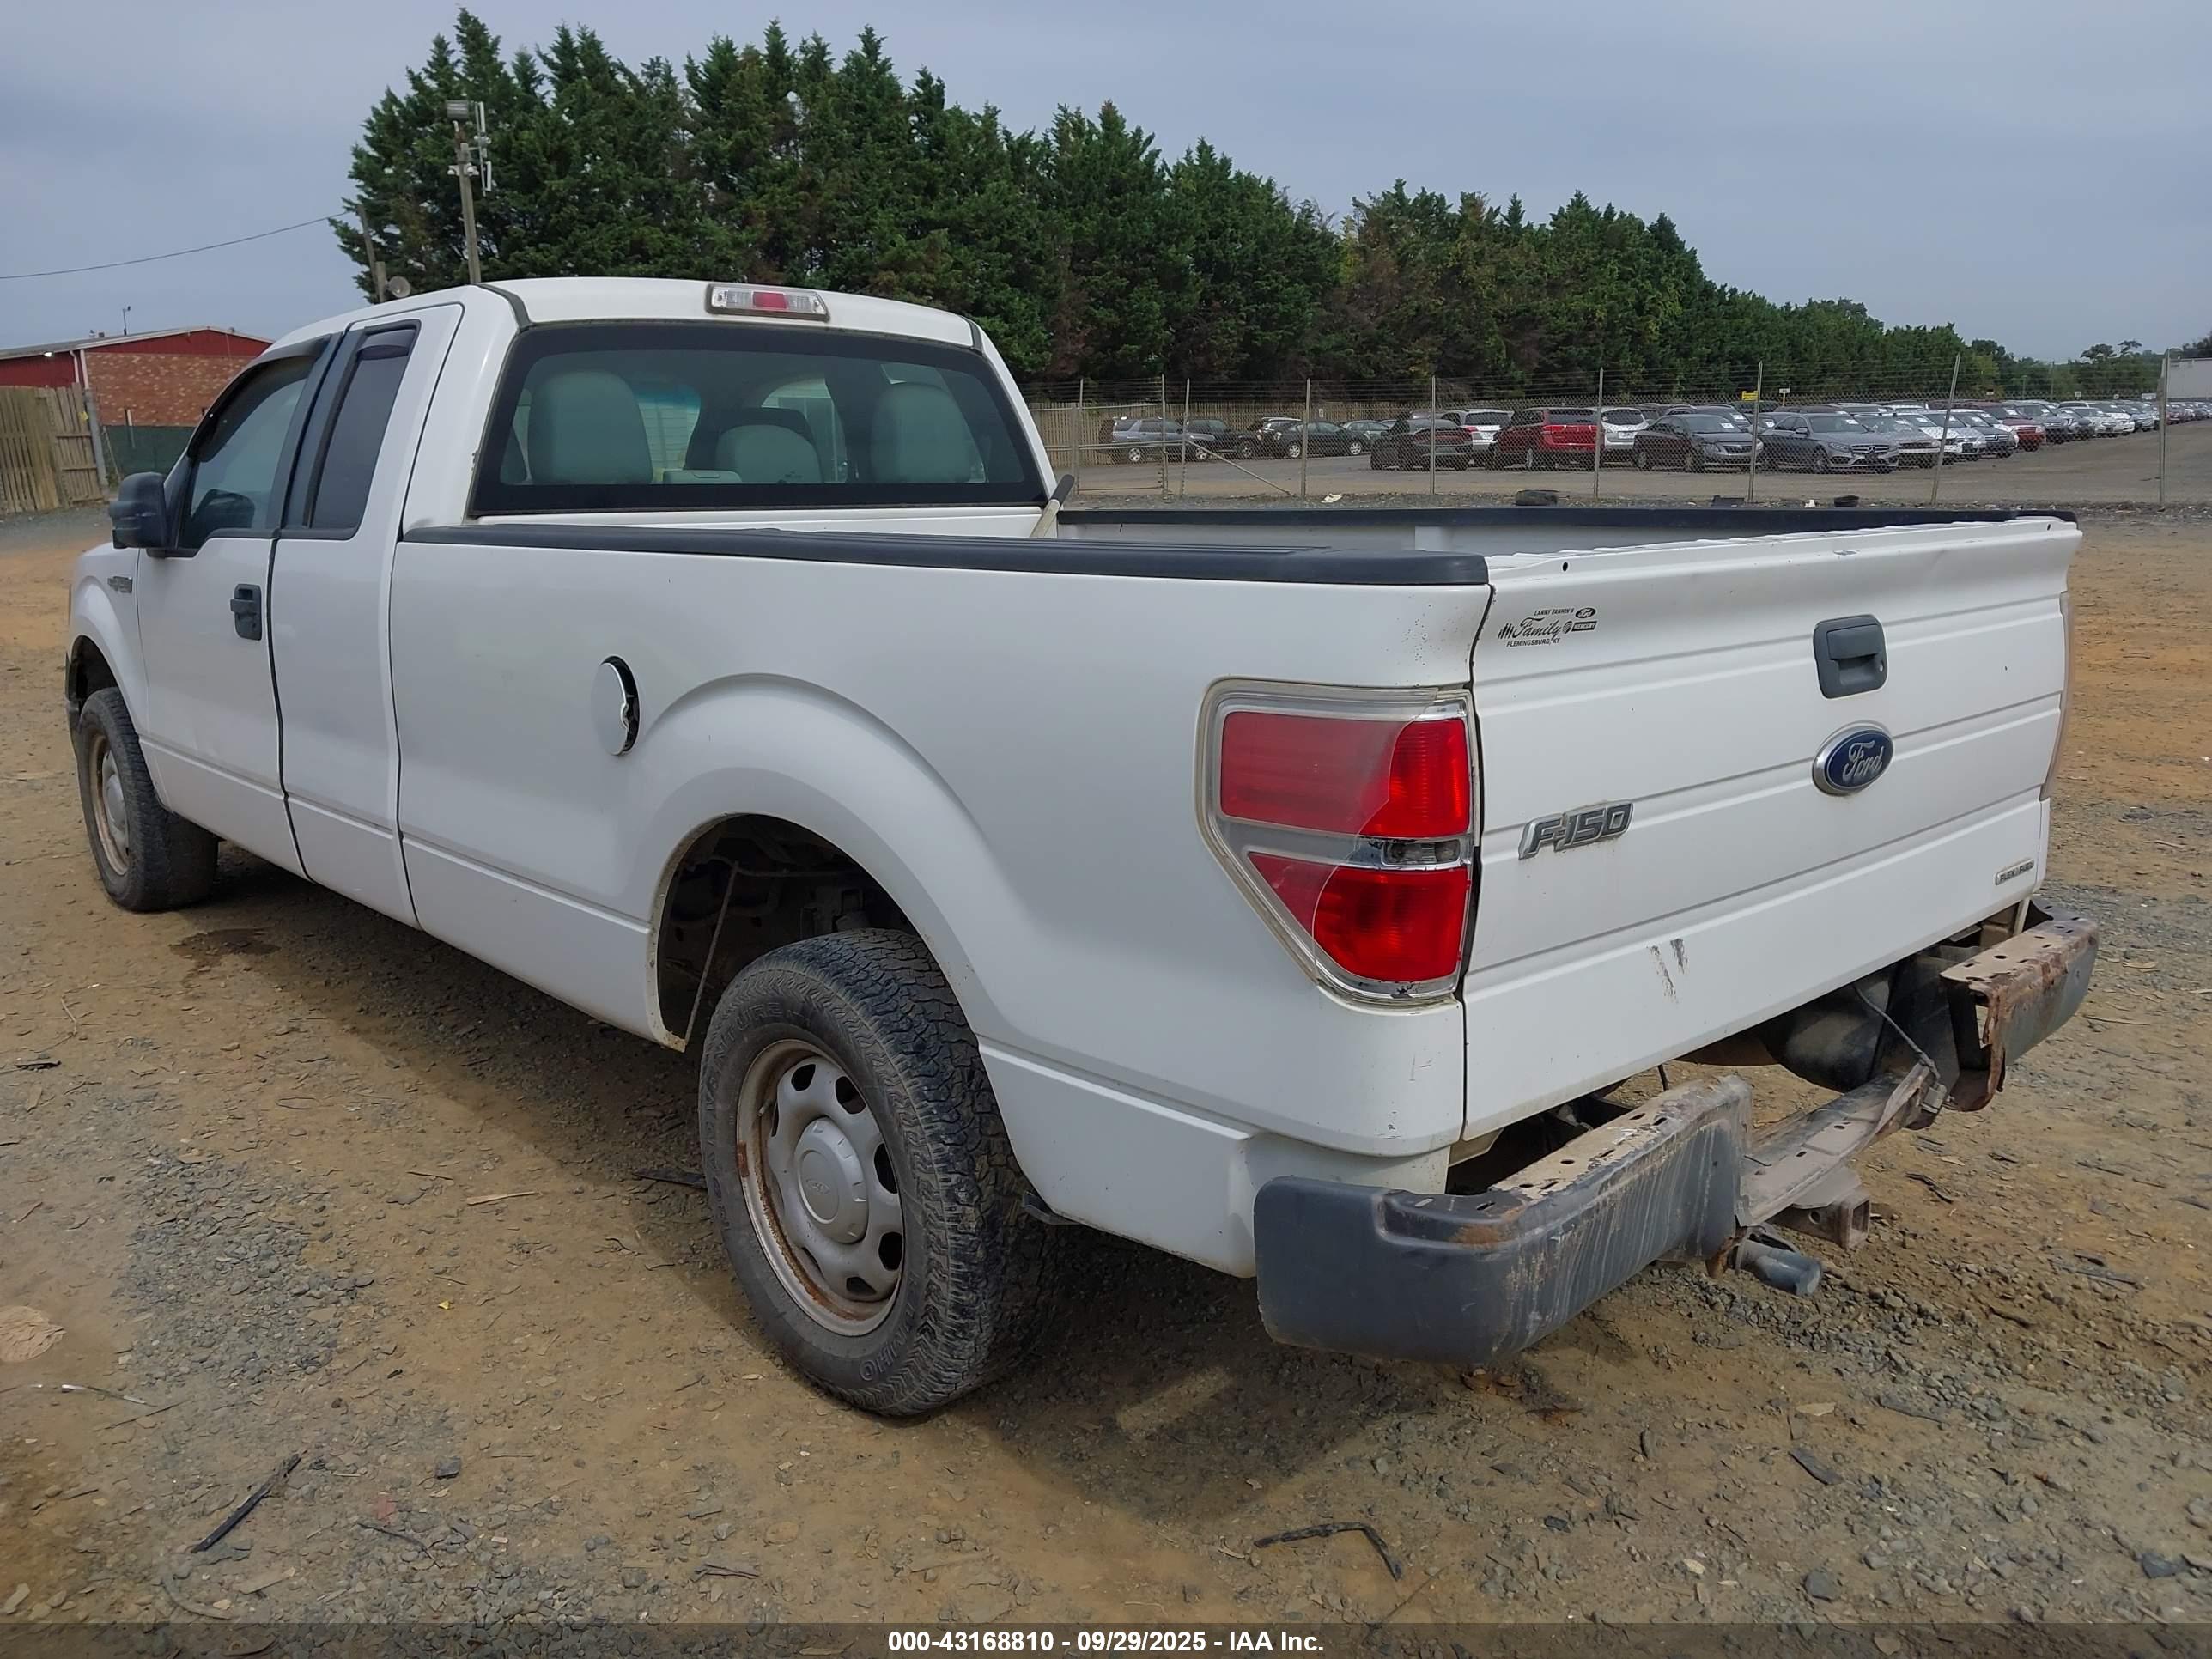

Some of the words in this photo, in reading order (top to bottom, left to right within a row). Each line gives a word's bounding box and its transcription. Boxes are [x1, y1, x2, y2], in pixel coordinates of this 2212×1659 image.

[1511, 616, 1563, 641] Family
[1842, 739, 1885, 779] Ford
[1518, 801, 1634, 860] F-150
